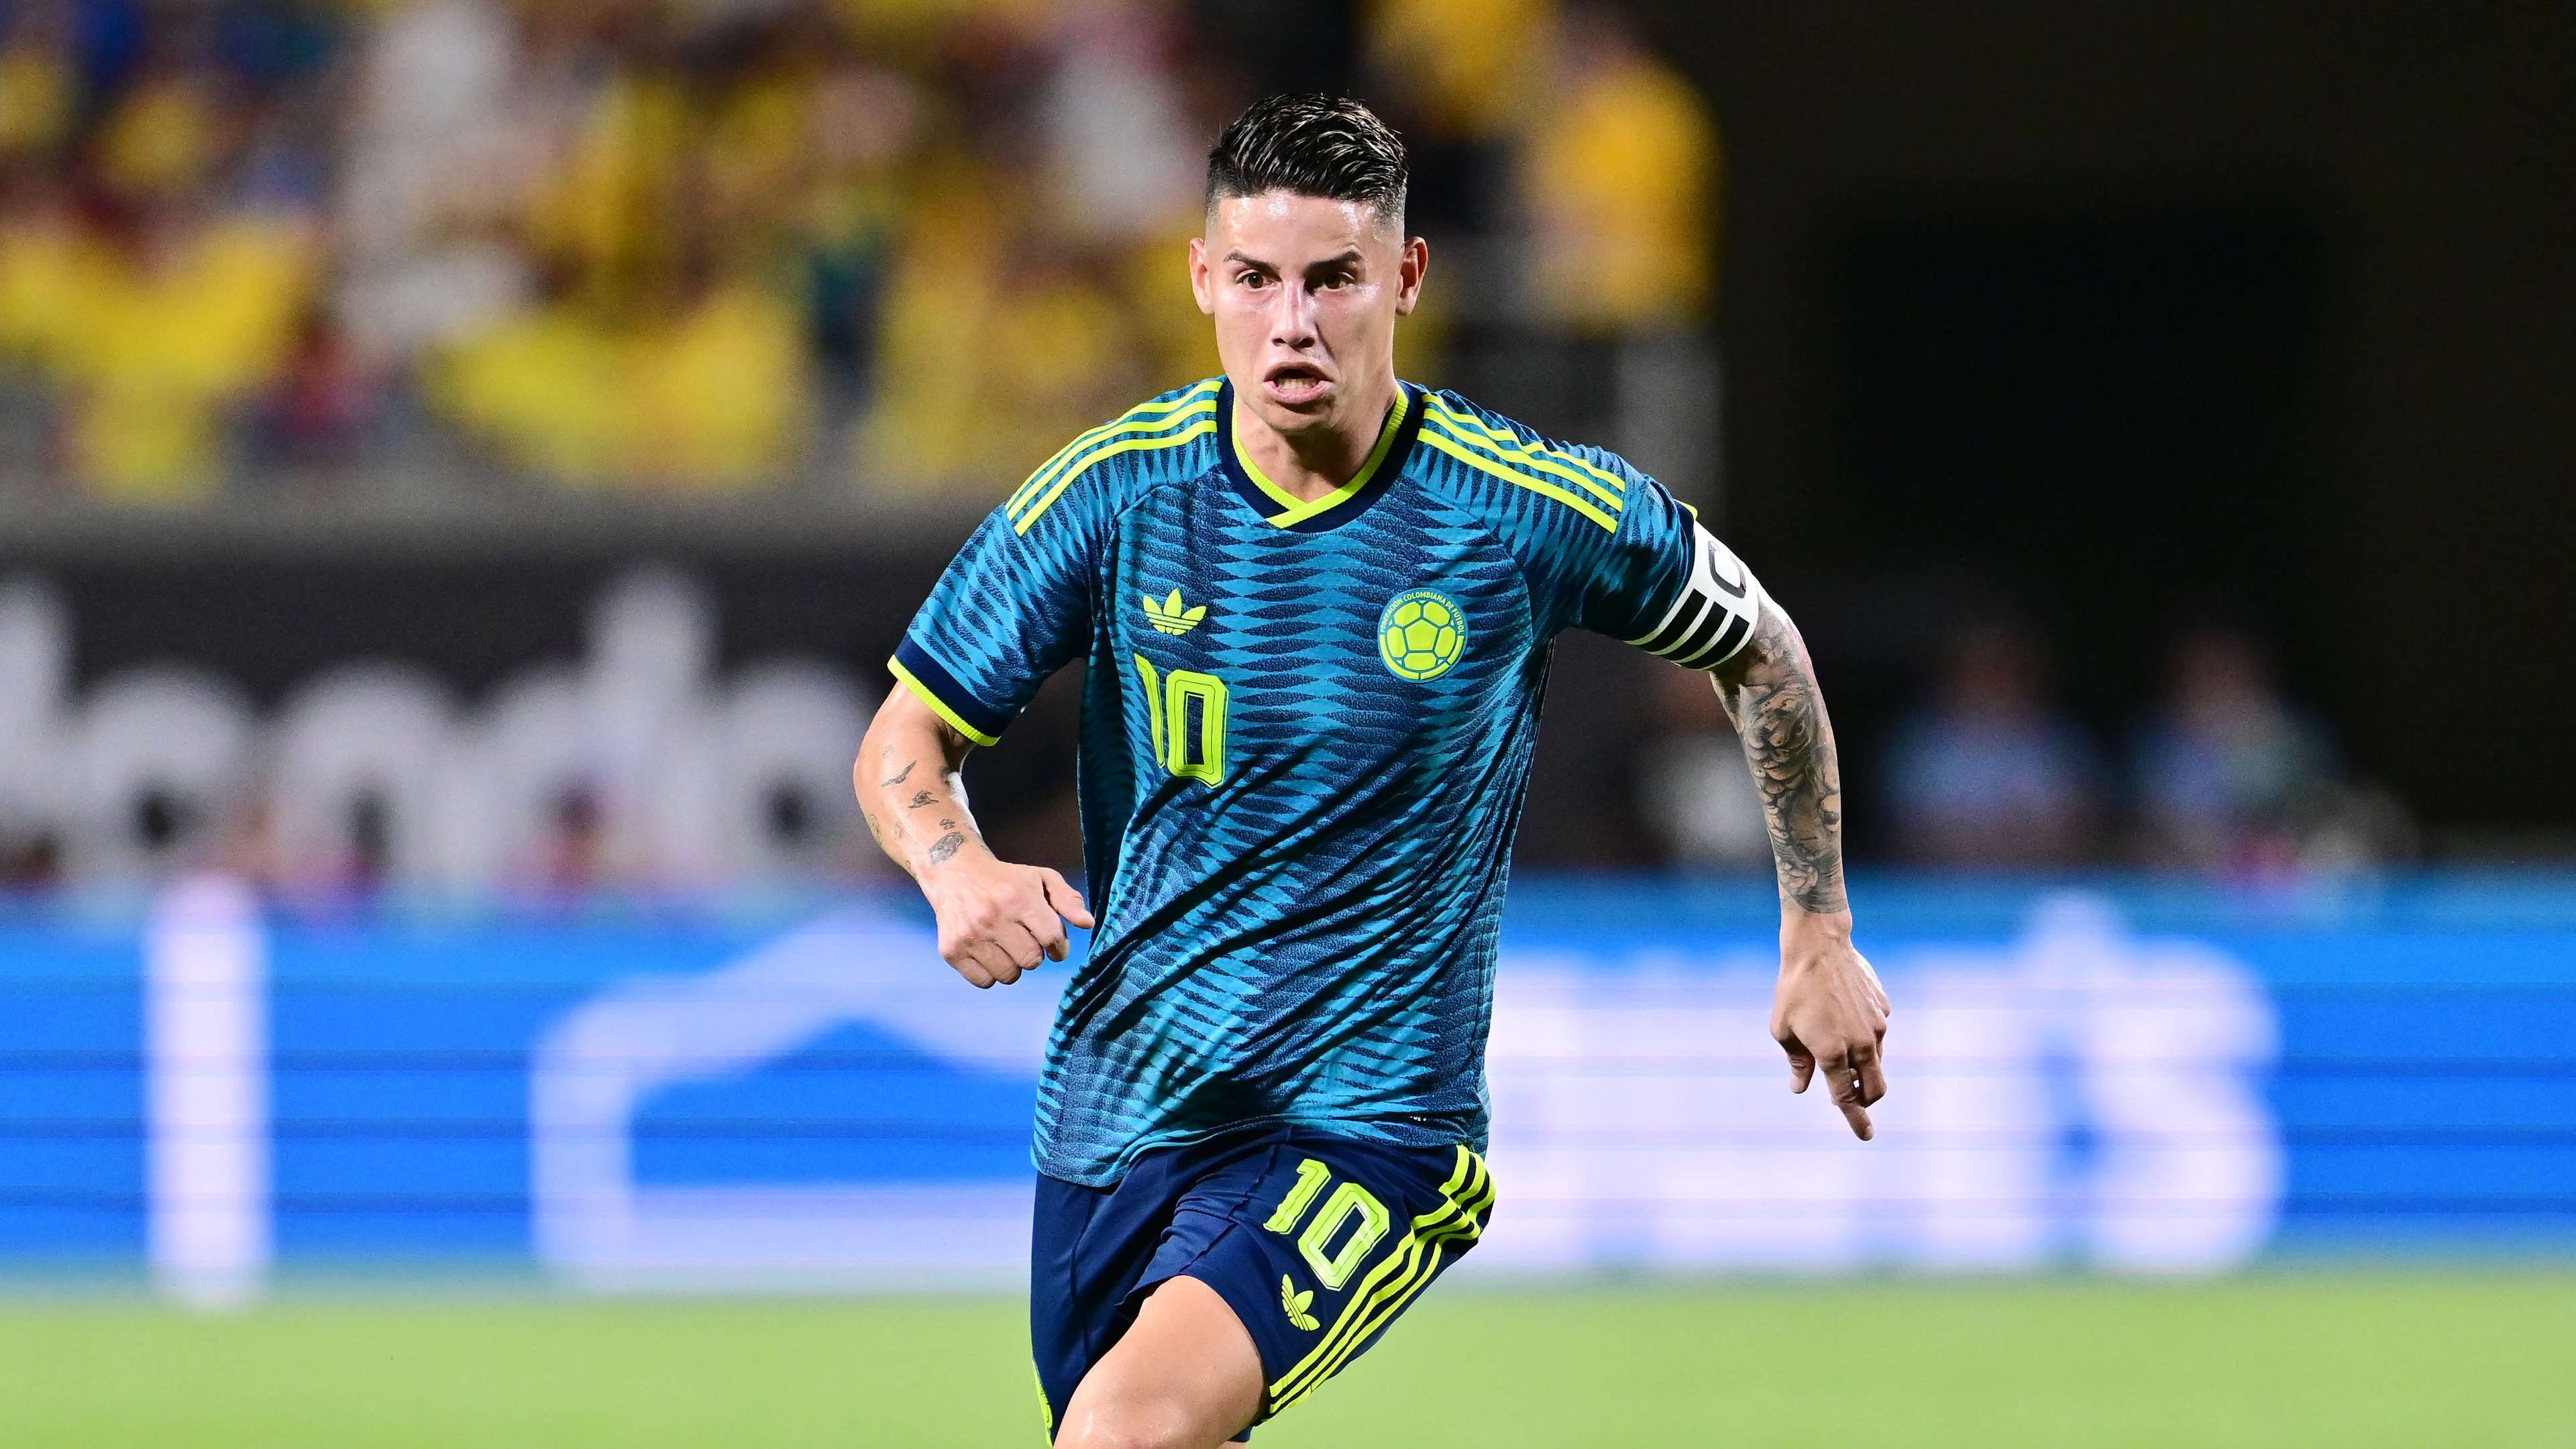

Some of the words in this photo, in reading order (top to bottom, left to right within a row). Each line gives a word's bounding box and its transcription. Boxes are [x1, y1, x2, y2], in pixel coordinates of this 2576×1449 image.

[1404, 591, 1446, 604] COLOMBIANA
[1446, 601, 1454, 610] DE
[1134, 652, 1229, 789] 10
[1263, 1159, 1390, 1291] 10
